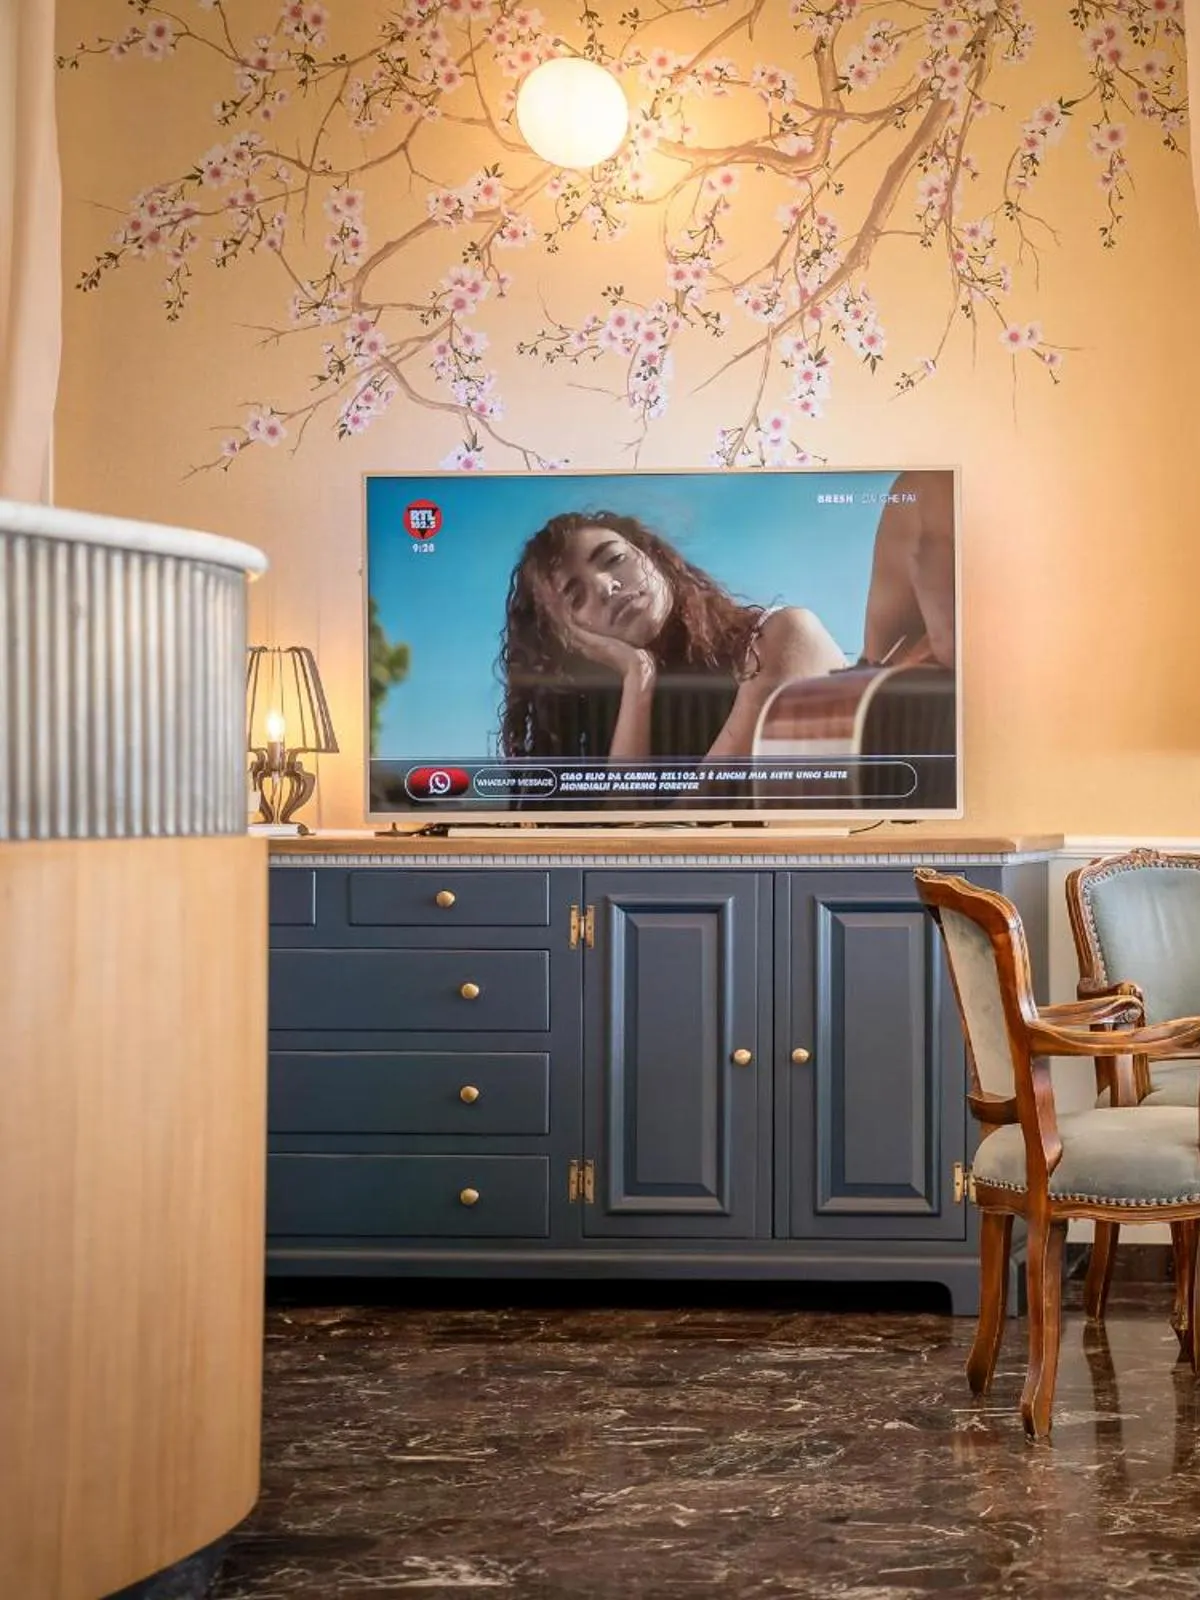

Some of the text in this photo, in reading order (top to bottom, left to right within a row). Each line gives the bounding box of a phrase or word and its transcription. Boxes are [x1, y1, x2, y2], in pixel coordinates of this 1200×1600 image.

[817, 494, 853, 503] BRESH
[410, 509, 436, 520] RTL
[410, 520, 436, 529] 102.5
[560, 772, 583, 781] CIAO
[585, 772, 606, 781] ELIO
[607, 772, 622, 780] DA
[715, 771, 747, 780] ANCHE
[748, 770, 768, 780] MIA
[770, 770, 794, 780] SIETE
[823, 770, 848, 779] SIETE
[612, 781, 657, 790] PALERMO
[658, 781, 700, 790] FOREVER
